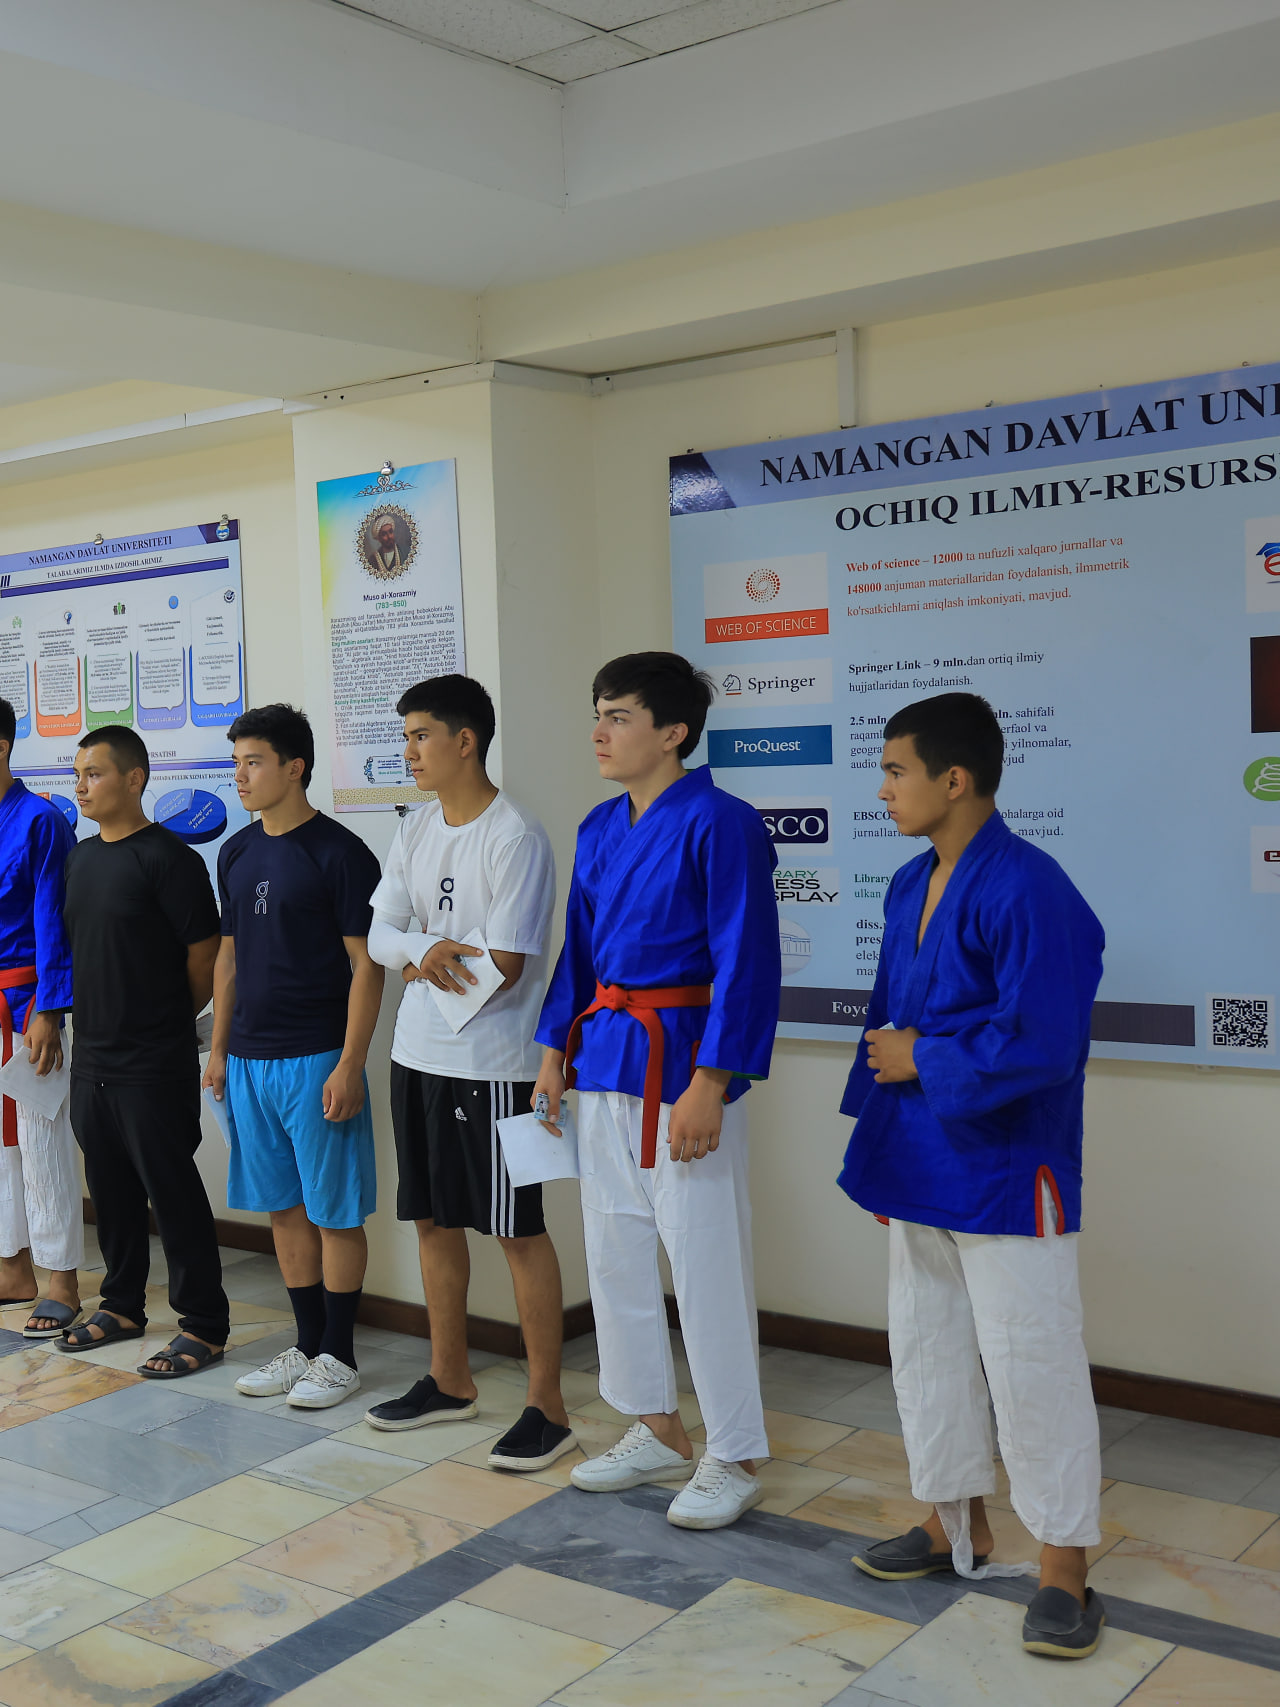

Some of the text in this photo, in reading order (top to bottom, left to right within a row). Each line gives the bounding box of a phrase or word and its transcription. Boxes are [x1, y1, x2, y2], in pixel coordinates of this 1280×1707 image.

[760, 426, 993, 487] NAMANGAN
[1003, 397, 1185, 454] DAVLAT
[835, 452, 1280, 531] OCHIQ ILMIY-RESURS
[28, 535, 173, 566] NAMANGAN DAVLAT UNIVERSITETI
[846, 561, 869, 573] Web
[871, 560, 882, 570] of
[884, 558, 920, 570] science
[933, 551, 963, 565] 12000
[966, 552, 976, 561] ta
[978, 546, 1014, 560] nufuzli
[1017, 544, 1057, 557] xalqaro
[1059, 537, 1107, 554] jurnallar
[1110, 537, 1123, 546] va
[847, 582, 882, 595] 148000
[884, 580, 926, 593] anjuman
[928, 571, 1004, 588] materiallaridan
[1007, 564, 1073, 582] foydalanish,
[363, 589, 417, 602] Muso al-Xorazmiy
[922, 596, 964, 612] aniqlash
[967, 591, 1025, 607] imkoniyati,
[1028, 587, 1072, 602] mavjud.
[715, 616, 817, 637] WEB OF SCIENCE
[848, 663, 893, 676] Springer
[896, 659, 921, 671] Link
[933, 658, 940, 668] 9
[988, 654, 1013, 667] ortiq
[1016, 651, 1044, 665] ilmiy
[748, 676, 816, 694] Springer
[849, 674, 973, 694] hujjatlaridan foydalanish.
[850, 716, 865, 726] 2.5
[1015, 706, 1055, 718] sahifali
[850, 722, 1047, 742] raqaml erfaol va
[734, 739, 801, 754] ProQuest
[851, 744, 882, 756] geogra
[1010, 736, 1072, 751] yilnomalar,
[851, 753, 1025, 769] audio vjud
[1001, 808, 1045, 821] ohalarga
[1047, 807, 1064, 818] oid
[762, 815, 825, 837] SCO
[772, 870, 818, 879] RARY
[775, 878, 821, 890] ESS
[854, 873, 891, 886] Library
[775, 891, 839, 902] PLAY
[854, 888, 881, 899] ulkan
[856, 919, 886, 930] diss.
[855, 935, 882, 947] pres
[855, 950, 880, 961] elek
